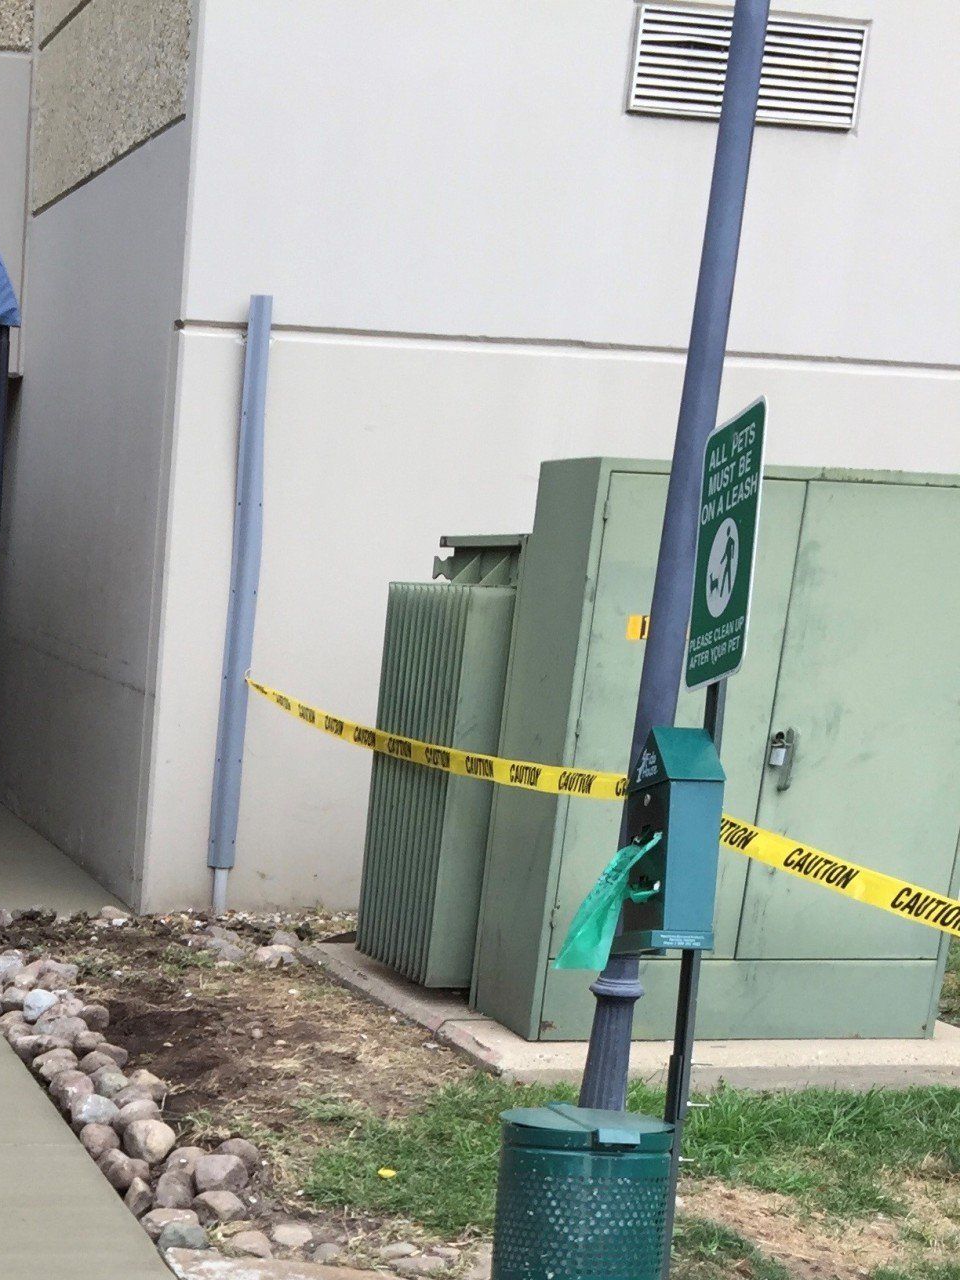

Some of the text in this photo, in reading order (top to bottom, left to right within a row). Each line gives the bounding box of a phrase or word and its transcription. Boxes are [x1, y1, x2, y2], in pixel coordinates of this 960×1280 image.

[709, 422, 756, 471] ALL PETS
[708, 449, 753, 497] MUST BE
[701, 471, 759, 526] ON A LEASH
[689, 630, 714, 652] PLEASE
[713, 620, 735, 642] CLEAN
[689, 650, 710, 670] AFTER
[727, 635, 740, 653] PET
[465, 755, 494, 778] CAUTION
[509, 764, 542, 787] CAUTION
[557, 771, 598, 795] CAUTION
[782, 846, 860, 891] CAUTION
[890, 885, 960, 932] CAUTIO
